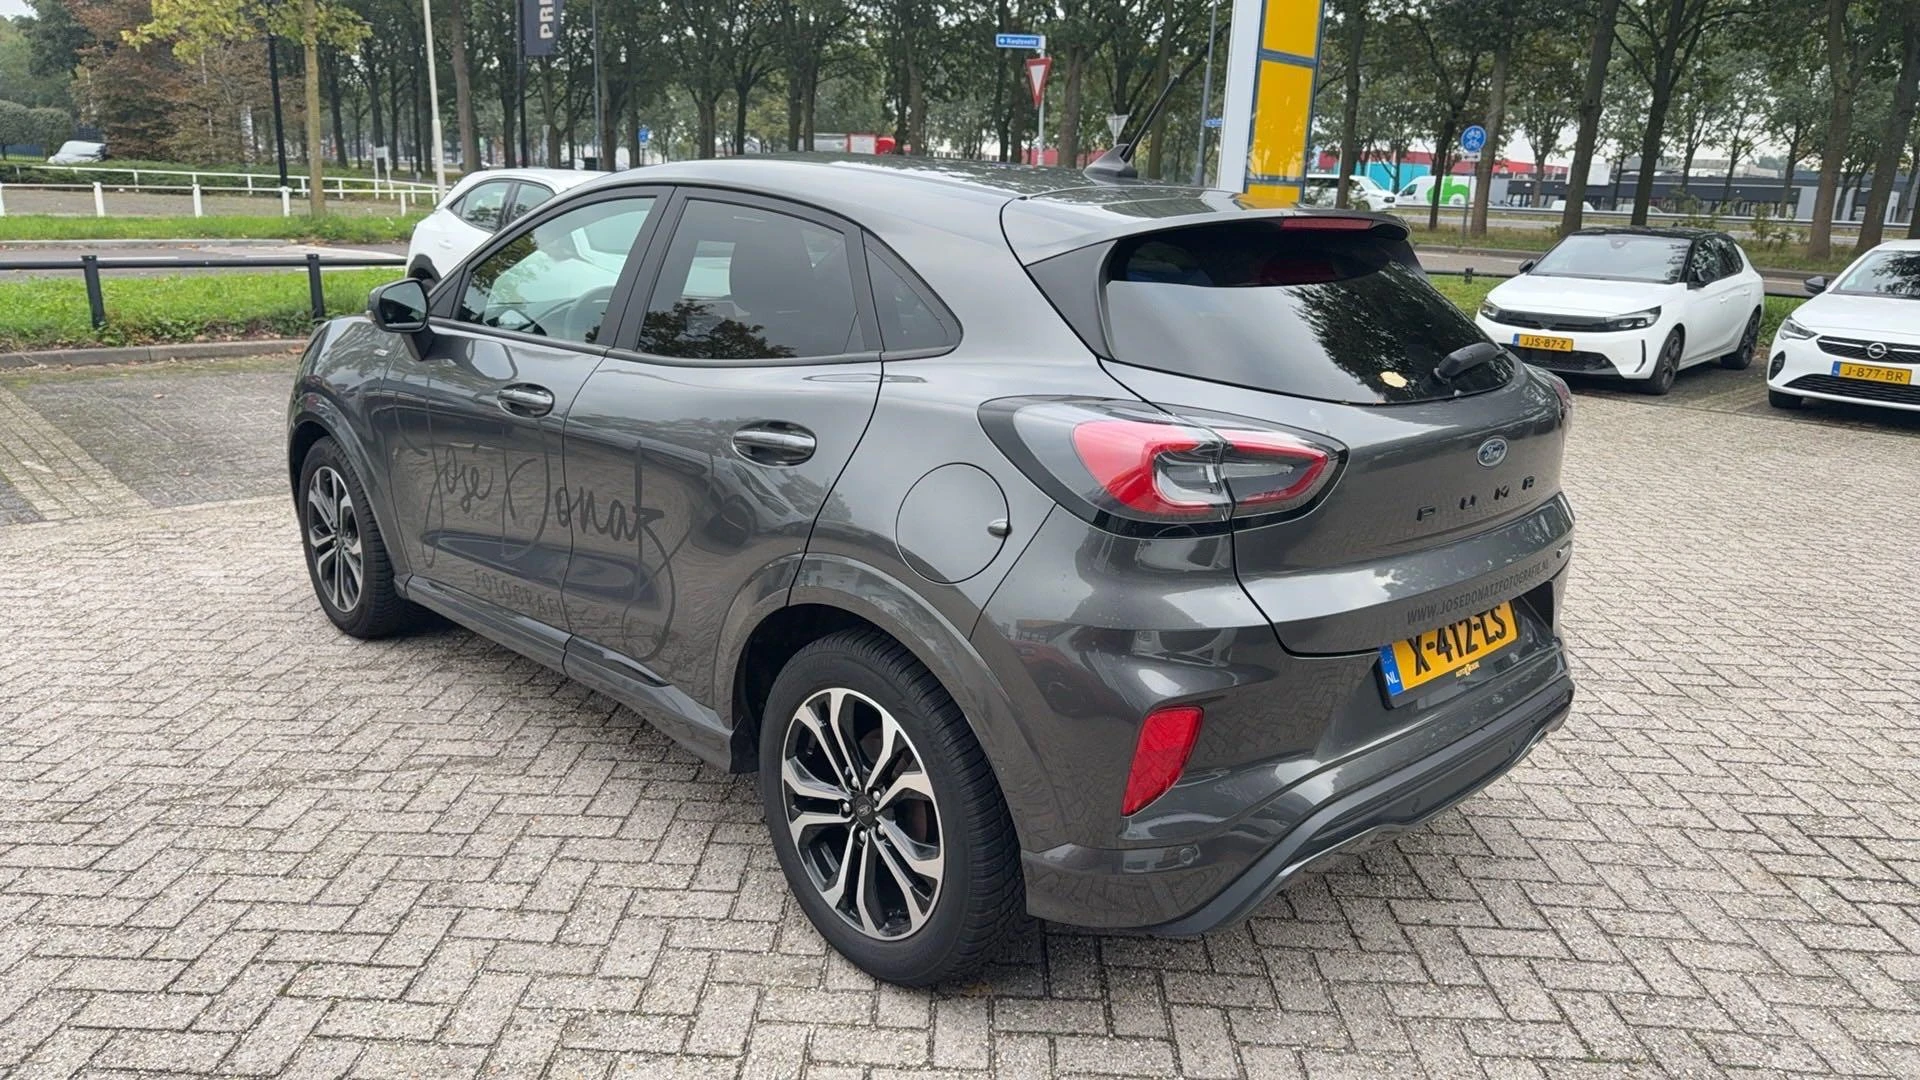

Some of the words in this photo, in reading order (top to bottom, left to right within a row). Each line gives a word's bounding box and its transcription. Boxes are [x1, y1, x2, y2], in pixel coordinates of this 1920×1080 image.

[1522, 337, 1567, 350] JJS-87-Z
[1845, 365, 1904, 382] J-877-BR
[1417, 475, 1535, 521] PUMA
[1406, 605, 1507, 676] X-412-LS
[1385, 671, 1399, 685] NL
